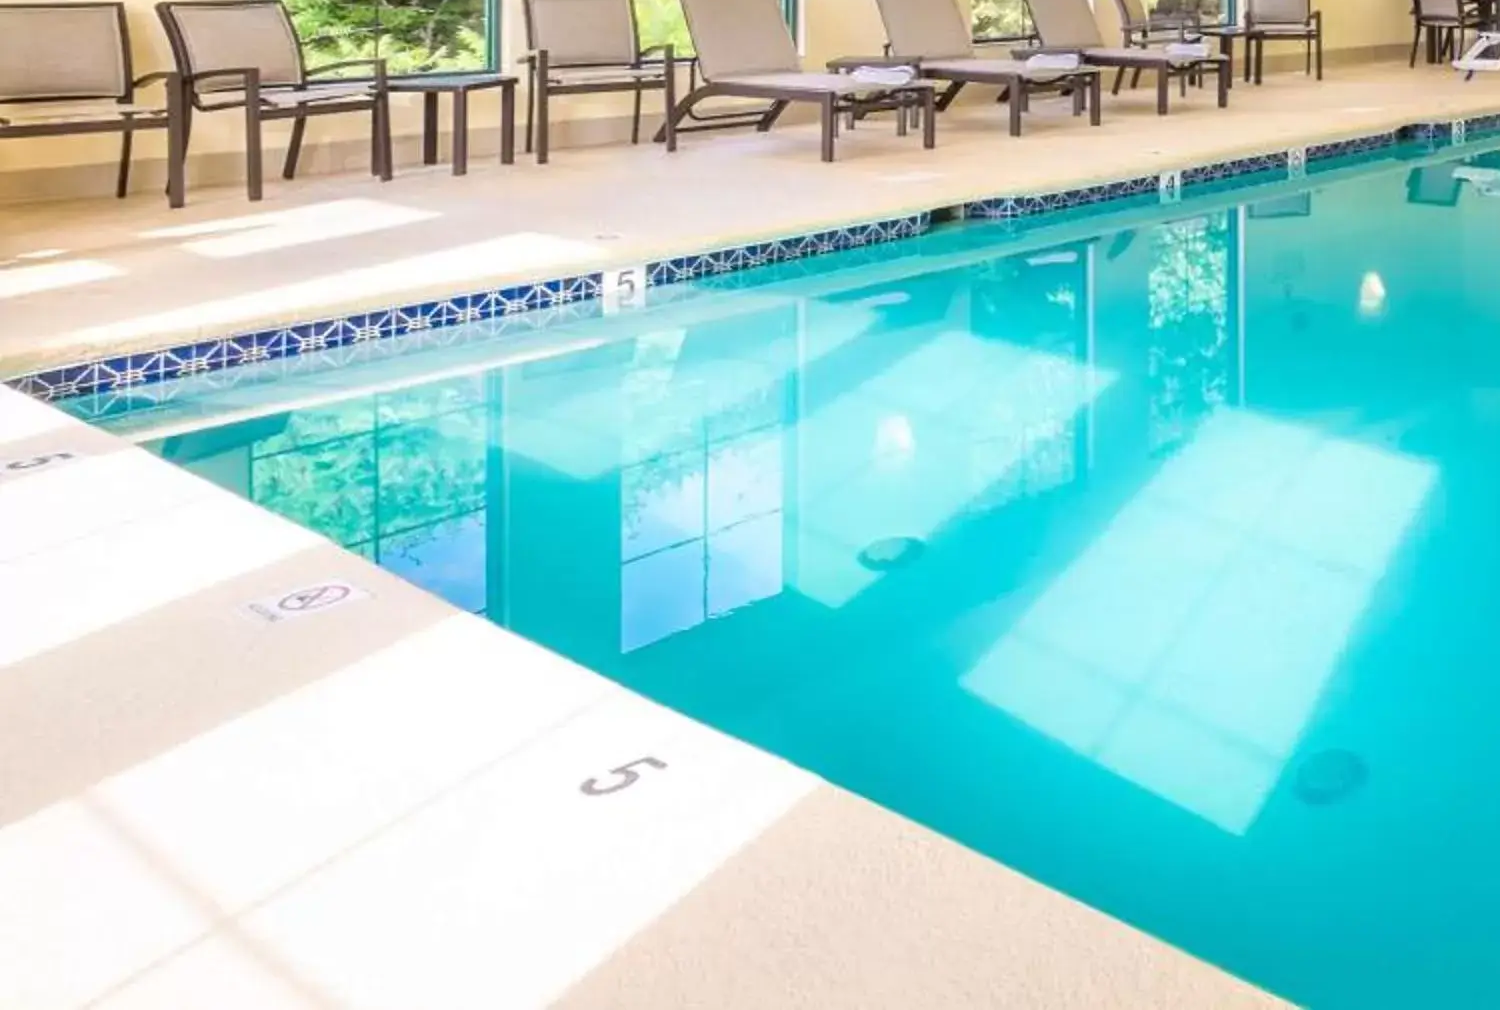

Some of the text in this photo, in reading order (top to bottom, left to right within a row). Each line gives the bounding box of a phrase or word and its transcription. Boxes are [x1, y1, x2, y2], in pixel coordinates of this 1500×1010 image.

[617, 270, 635, 297] 5
[6, 452, 76, 470] 5
[579, 756, 668, 796] 5
